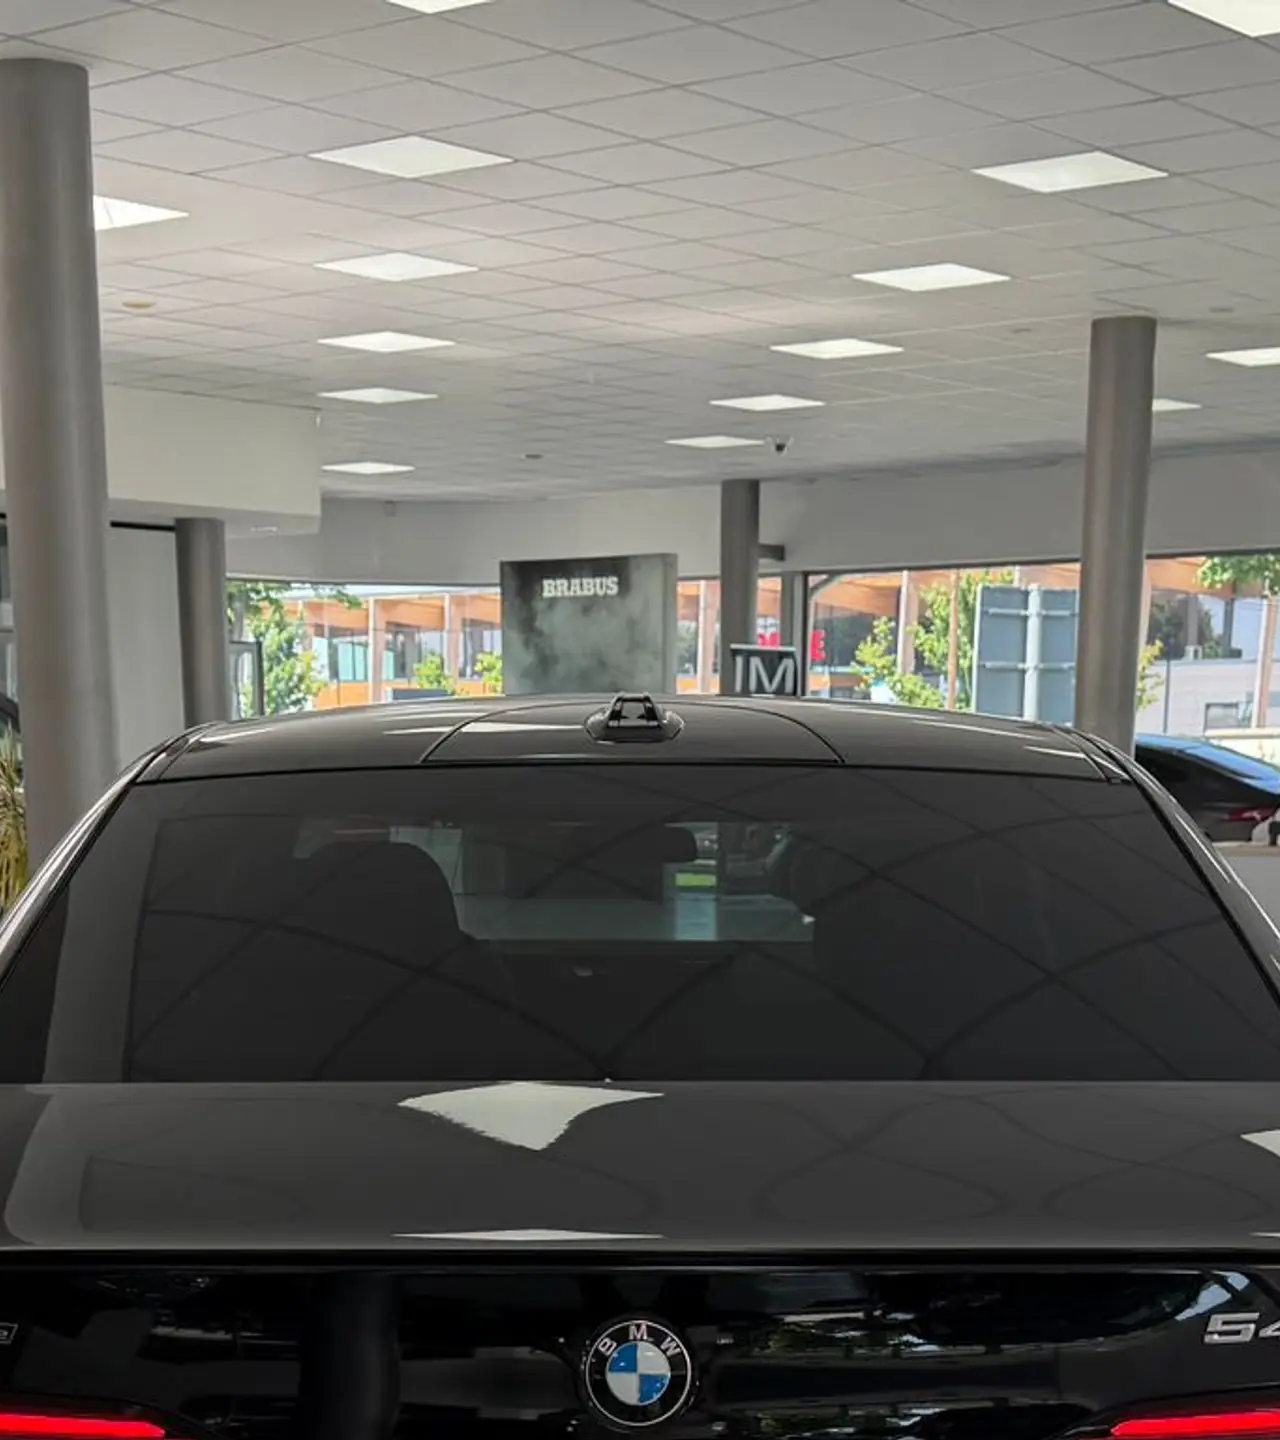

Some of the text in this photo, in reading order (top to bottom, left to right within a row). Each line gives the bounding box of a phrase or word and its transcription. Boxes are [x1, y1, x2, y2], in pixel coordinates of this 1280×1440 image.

[542, 576, 619, 599] BRABUS
[734, 654, 795, 693] IM
[597, 1322, 681, 1357] BMW
